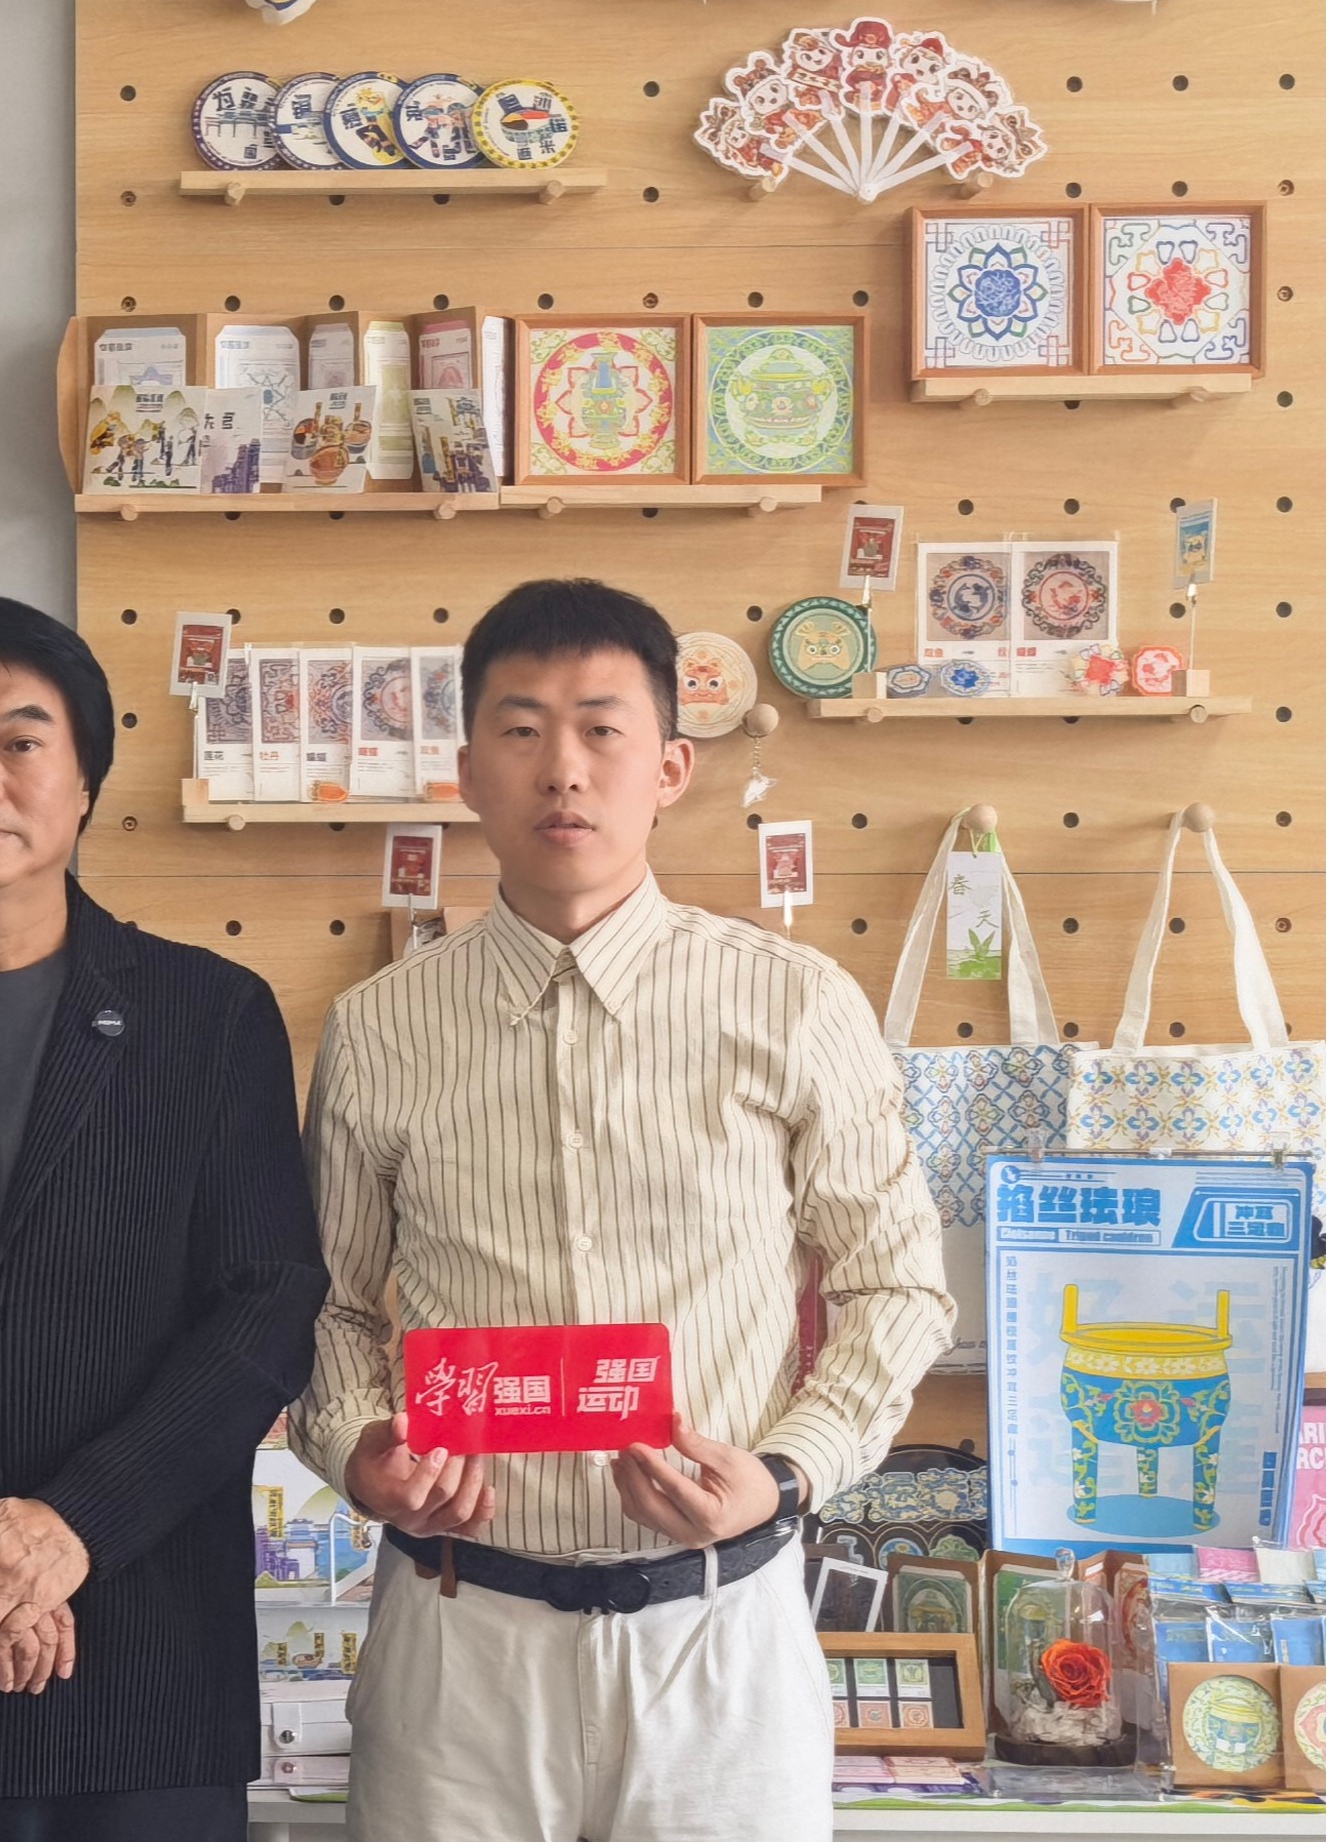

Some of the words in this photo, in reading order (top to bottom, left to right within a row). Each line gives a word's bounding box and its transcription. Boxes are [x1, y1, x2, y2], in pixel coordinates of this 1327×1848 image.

[593, 1355, 662, 1384] 强国
[494, 1405, 552, 1416] xuexi.cn
[576, 1385, 641, 1421] 运动
